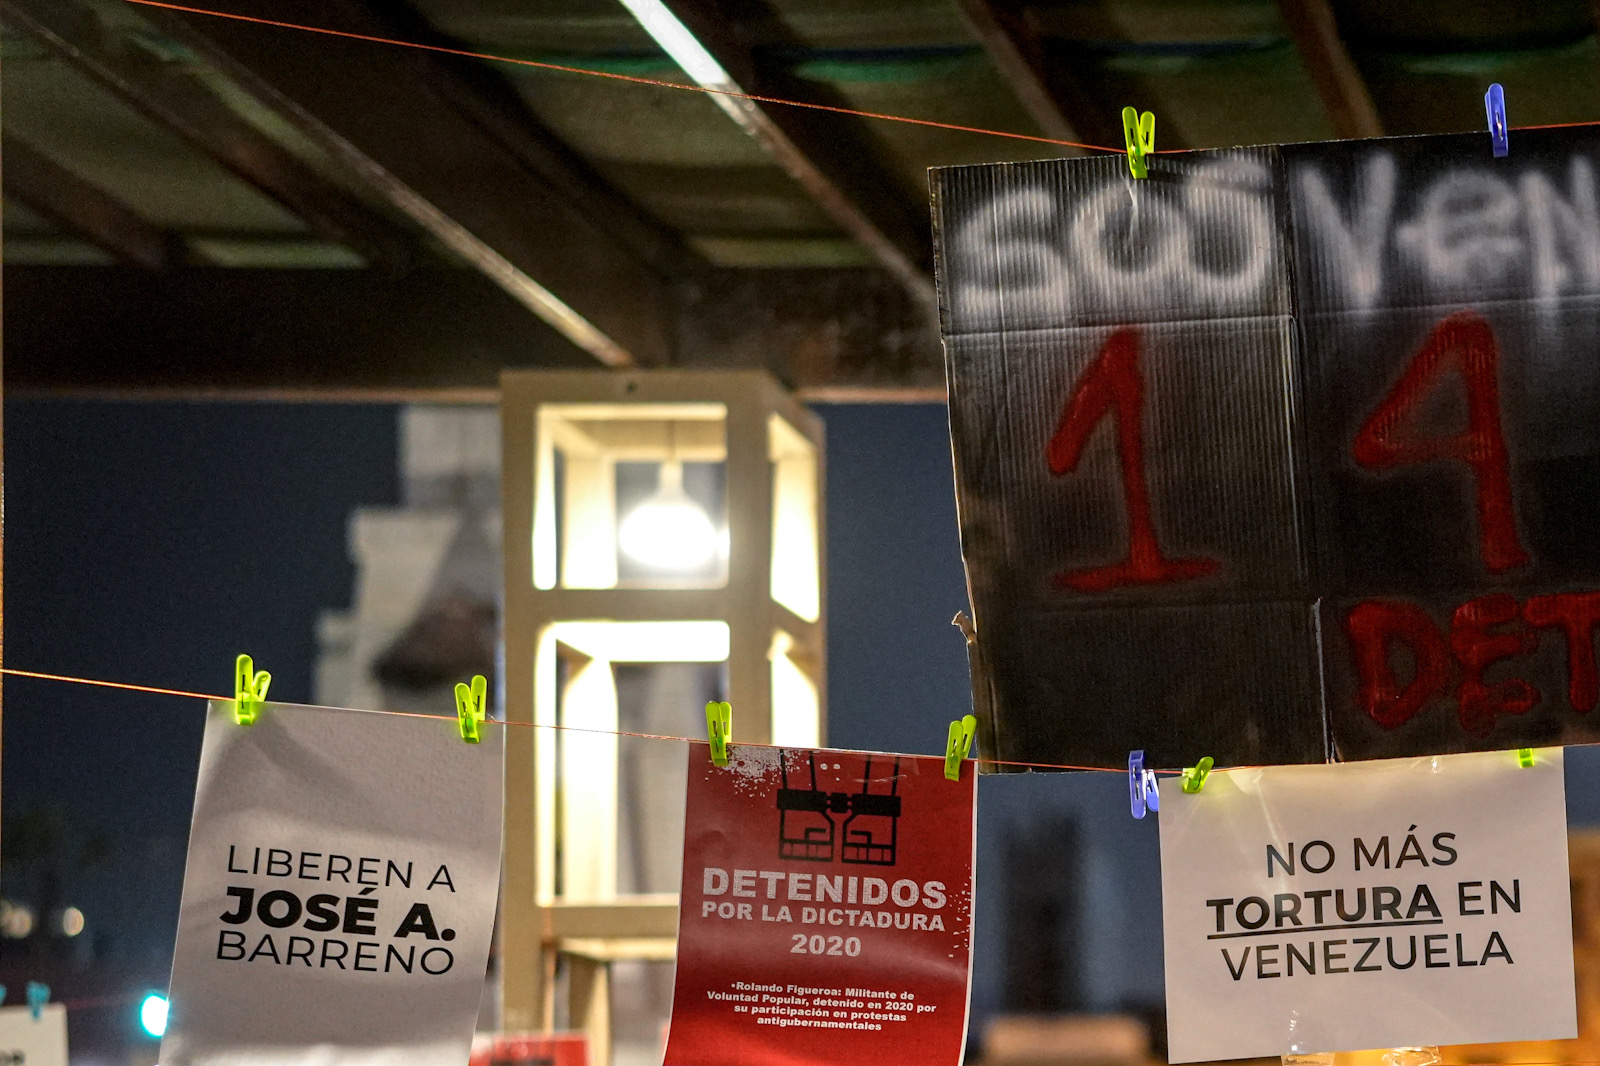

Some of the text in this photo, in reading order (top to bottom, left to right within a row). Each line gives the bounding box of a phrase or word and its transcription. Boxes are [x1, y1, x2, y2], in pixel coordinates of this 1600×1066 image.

[227, 845, 456, 893] LIBEREN A
[1267, 824, 1457, 877] NO MÁS
[703, 867, 947, 909] DETENIDOS
[1207, 879, 1520, 934] TORTURA EN
[219, 885, 456, 942] JOSÉ A.
[702, 901, 945, 931] POR LA DICTADURA
[216, 930, 454, 975] BARRENO
[790, 933, 861, 957] 2020
[1221, 931, 1514, 980] VENEZUELA
[707, 990, 758, 1002] Voluntad
[762, 994, 810, 1006] Popular,
[813, 996, 864, 1008] detenido
[885, 1001, 913, 1011] 2020
[917, 1003, 936, 1014] por
[751, 1004, 830, 1018] participación
[833, 1010, 848, 1018] en
[851, 1010, 907, 1022] protestas
[787, 985, 842, 998] Figueroa:
[845, 988, 897, 999] Militante
[900, 991, 914, 1000] de
[757, 1016, 882, 1031] antigubernamentales
